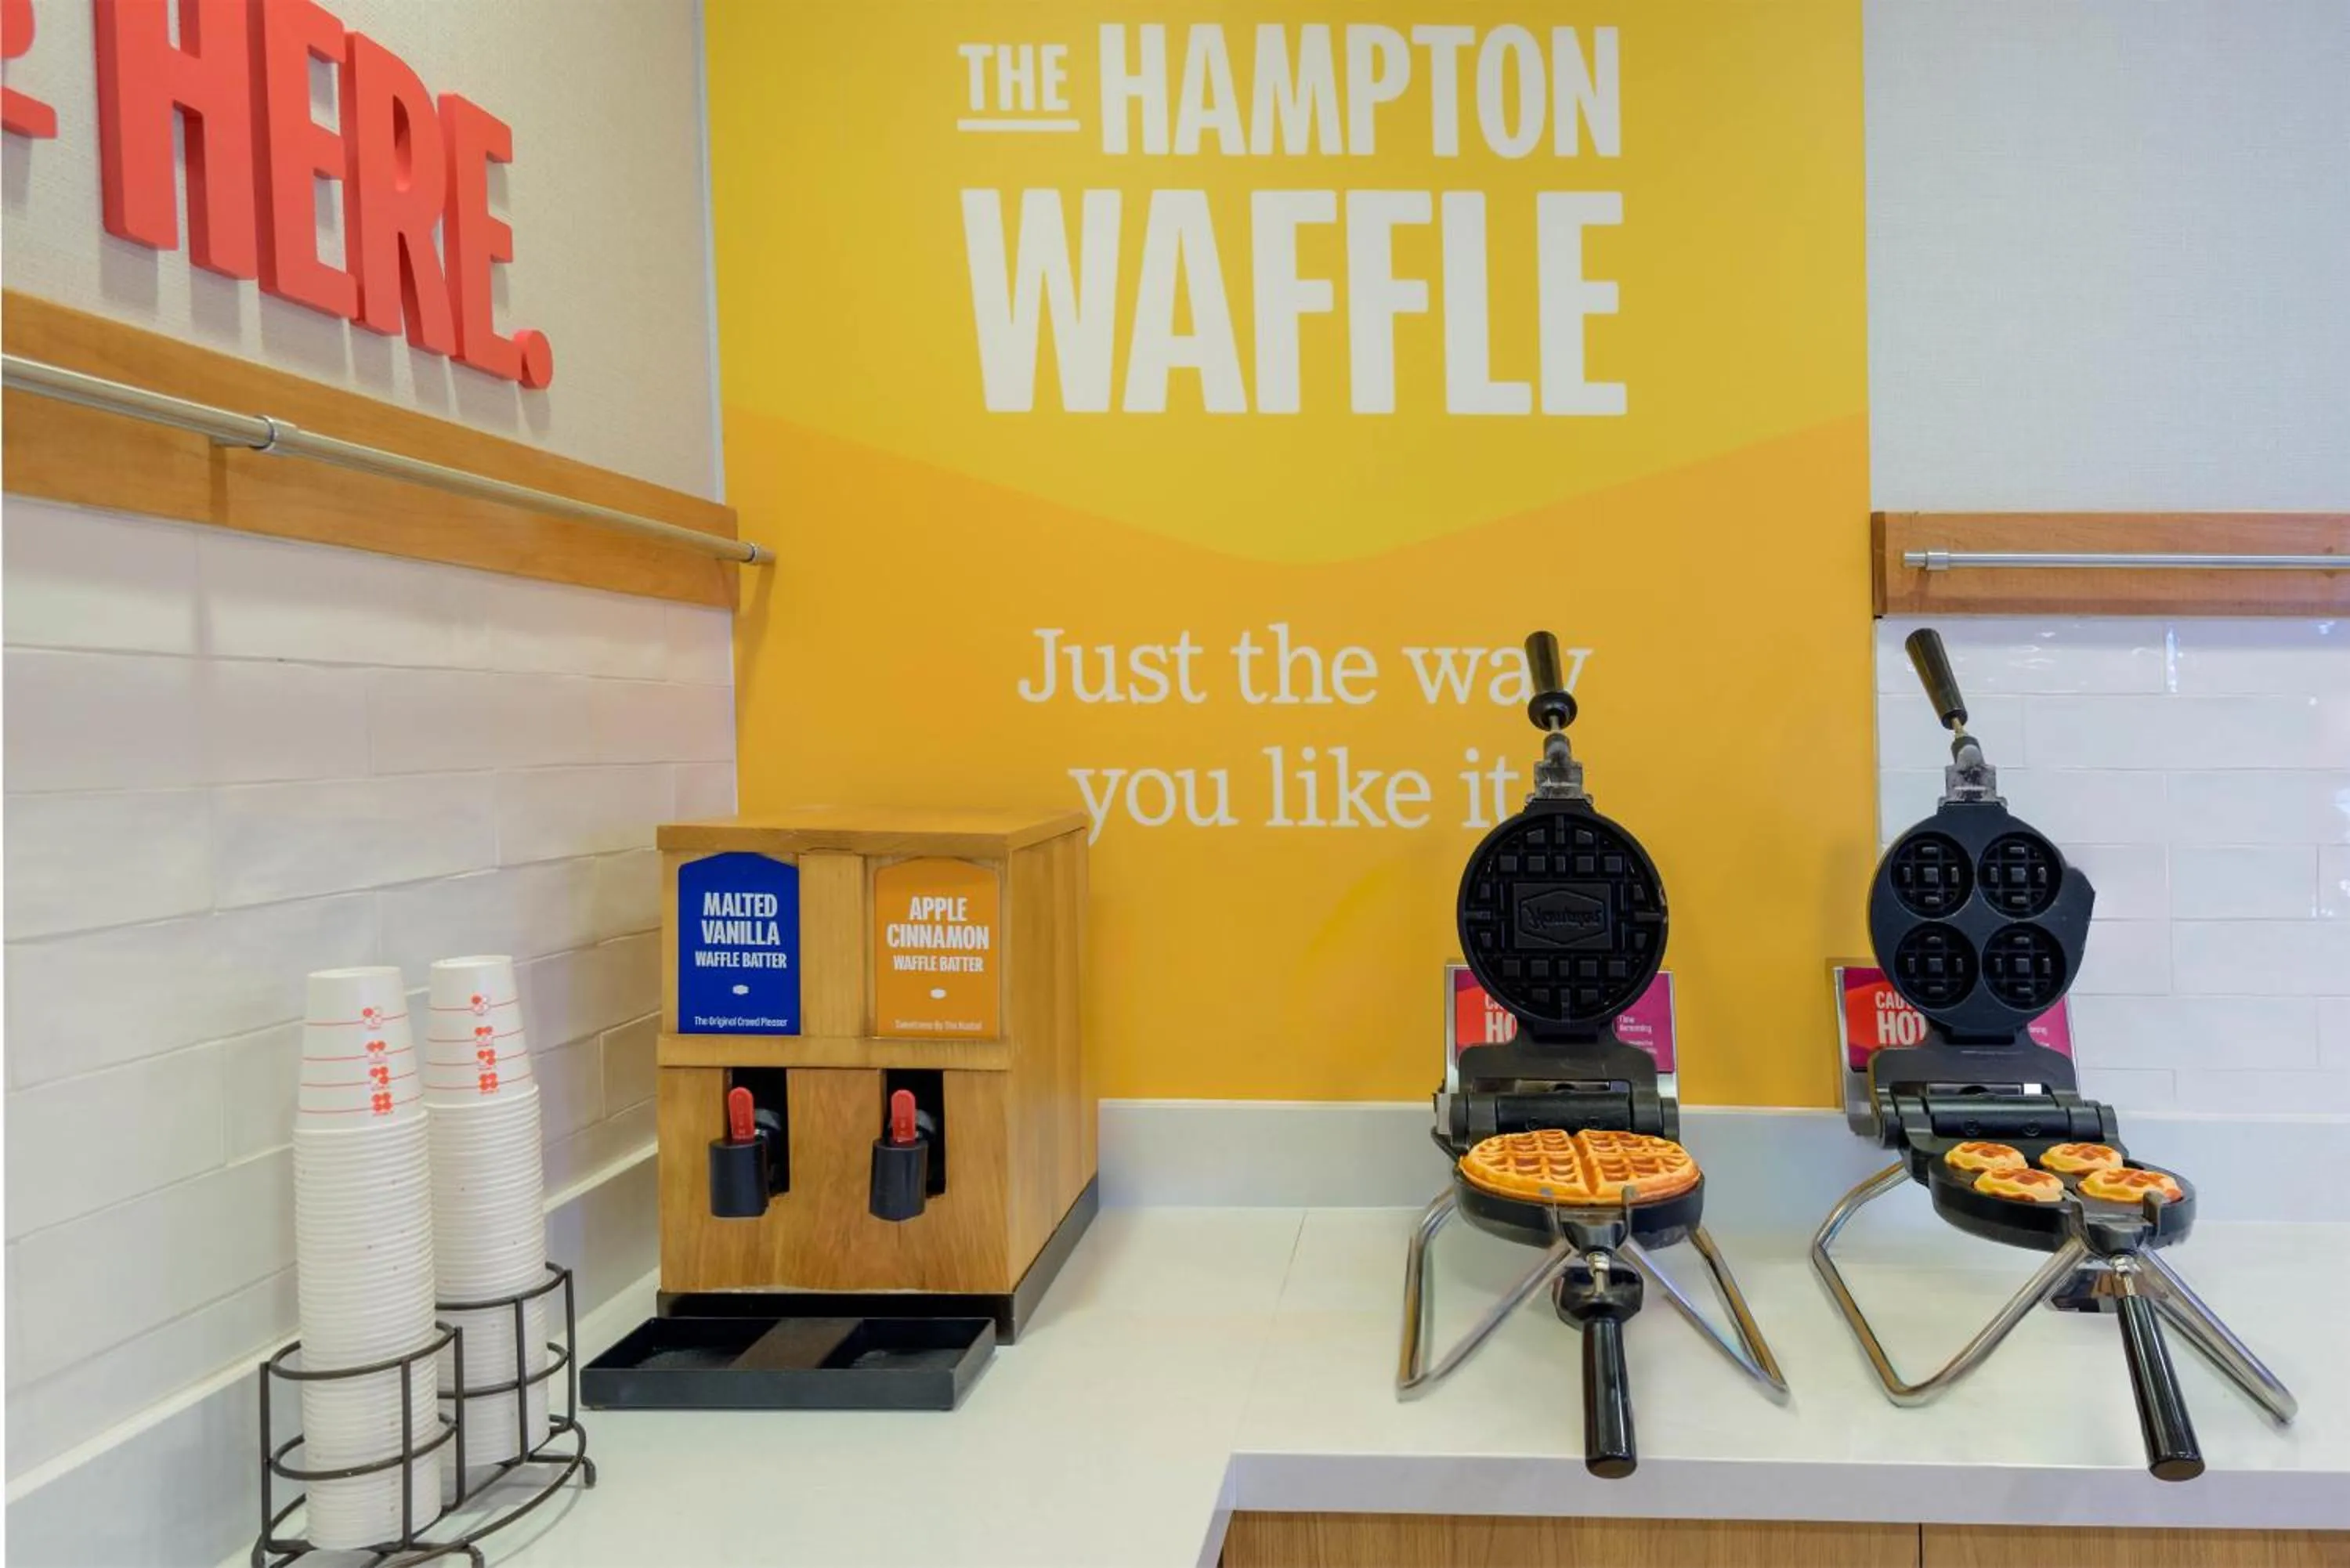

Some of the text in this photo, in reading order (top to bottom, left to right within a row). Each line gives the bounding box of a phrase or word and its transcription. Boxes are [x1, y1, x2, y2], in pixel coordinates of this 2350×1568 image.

[958, 23, 1622, 159] THE HAMPTON
[94, 0, 553, 390] HERE.
[960, 189, 1628, 416] WAFFLE
[1018, 627, 1207, 705] Just
[1231, 621, 1379, 705] the
[1066, 768, 1240, 848] you
[1262, 746, 1432, 828] like
[703, 891, 779, 917] MALTED
[909, 896, 967, 922] APPLE
[701, 919, 781, 945] VANILLA
[886, 923, 990, 949] CINNAMON
[695, 951, 787, 969] WAFFLE BATTER
[893, 954, 985, 972] WAFFLE BATTER
